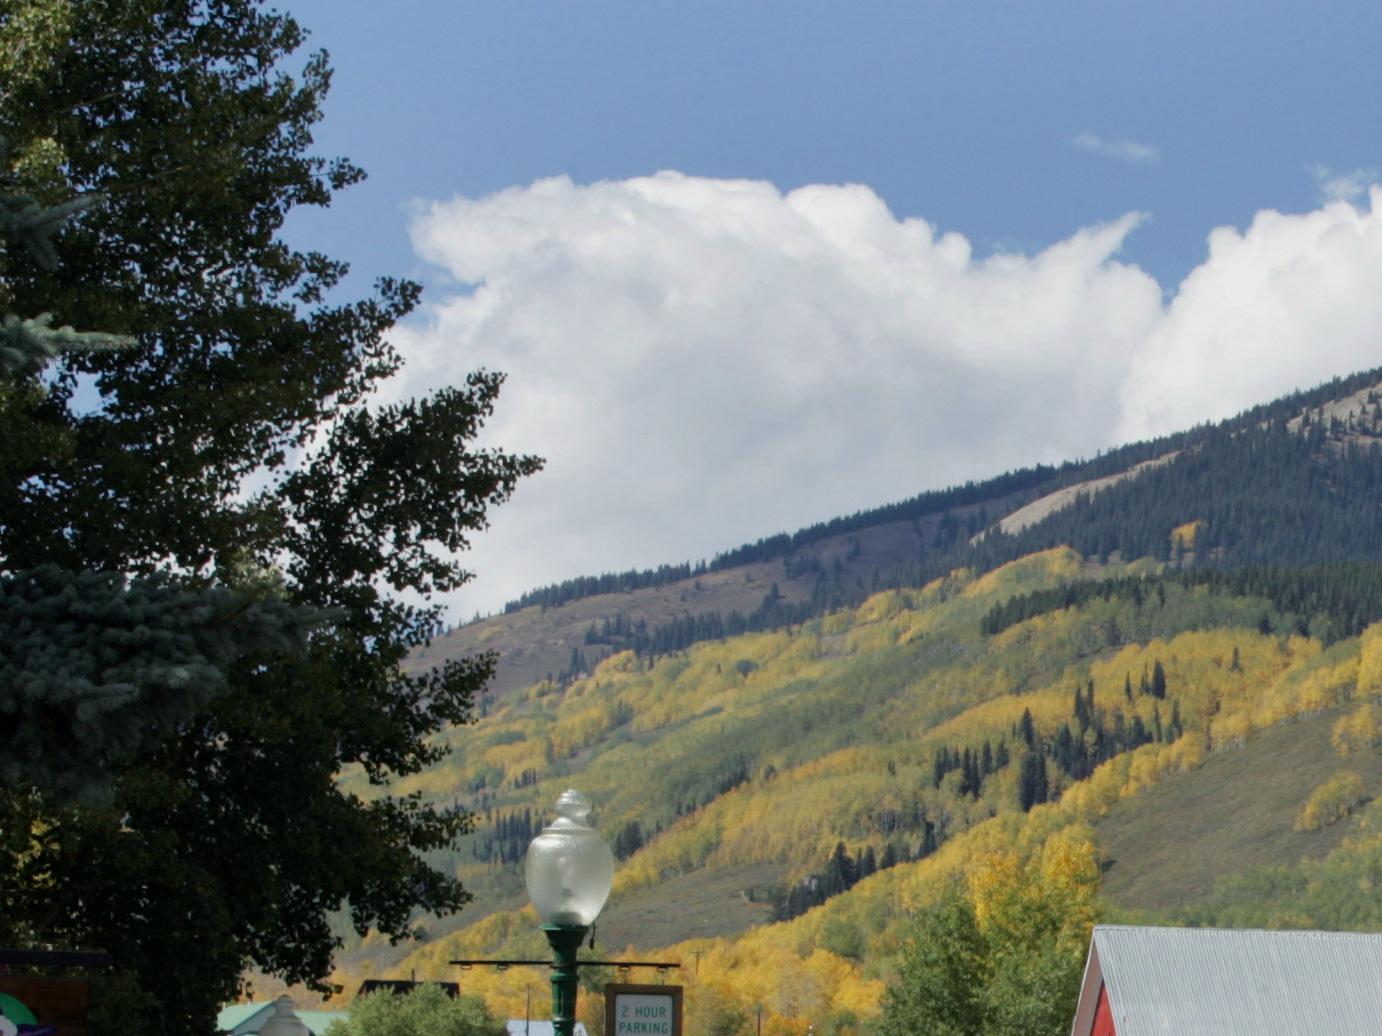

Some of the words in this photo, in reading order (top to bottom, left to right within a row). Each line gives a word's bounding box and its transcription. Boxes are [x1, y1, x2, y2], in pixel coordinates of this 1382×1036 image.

[621, 1006, 630, 1018] 2
[635, 1006, 667, 1018] HOUR
[619, 1022, 669, 1034] PARKING
